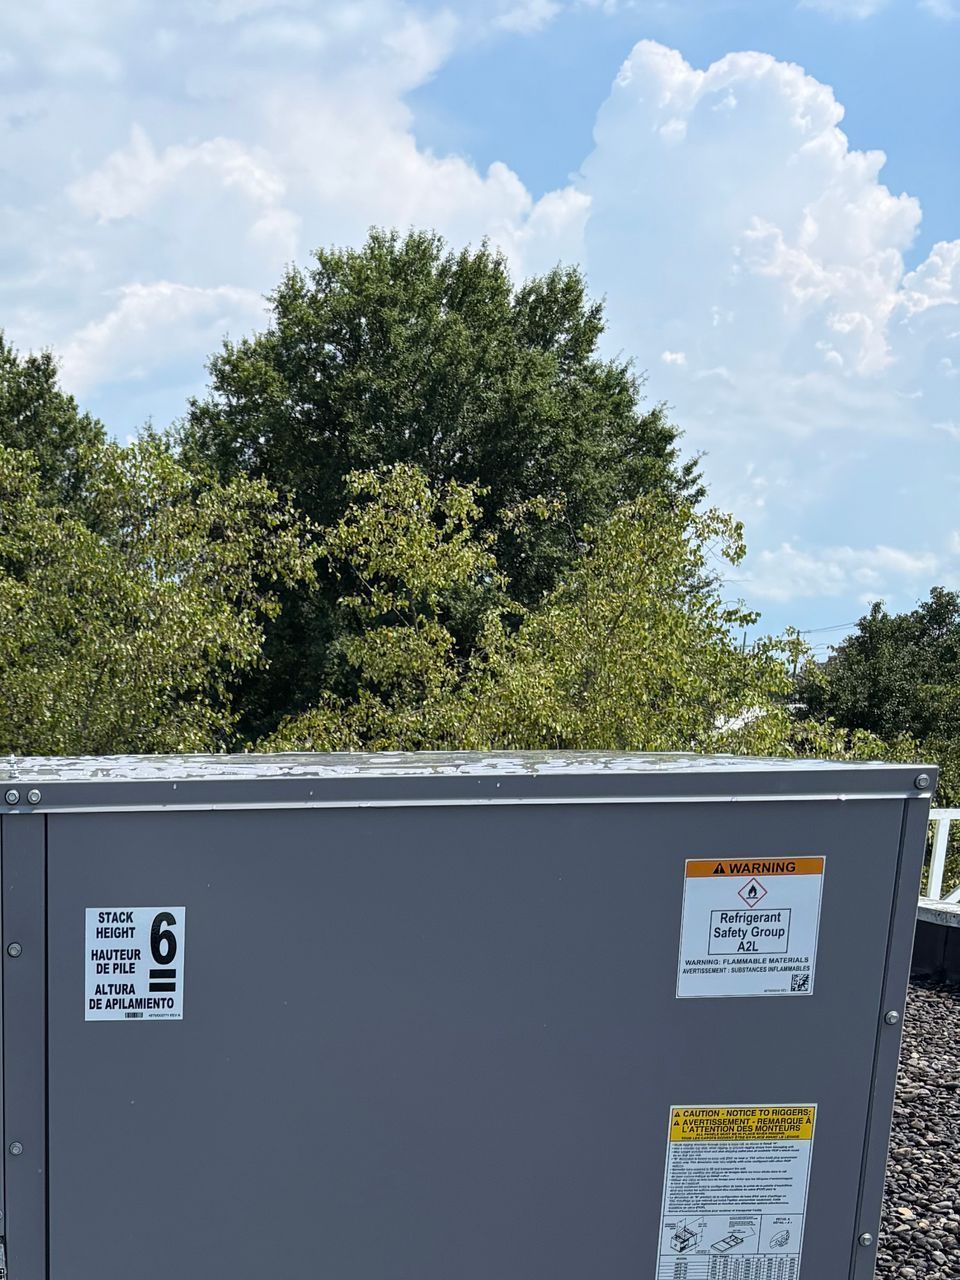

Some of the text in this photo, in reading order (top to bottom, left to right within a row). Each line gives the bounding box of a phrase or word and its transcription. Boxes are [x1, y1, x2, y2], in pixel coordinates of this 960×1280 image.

[729, 862, 796, 874] WARNING
[98, 912, 133, 923] STACK
[720, 912, 781, 925] Refrigerant
[96, 927, 136, 939] HEIGHT
[714, 926, 785, 939] Safety Group
[151, 912, 177, 965] 6
[737, 941, 758, 952] A2L
[91, 949, 141, 961] HAUTEUR
[96, 963, 135, 974] DE PILE
[95, 984, 135, 995] ALTURA
[89, 998, 174, 1009] DE APILAMIENTO
[726, 1109, 756, 1117] NOTICE
[682, 1125, 734, 1133] L'ATTENTION
[754, 1124, 801, 1132] MONTEURS
